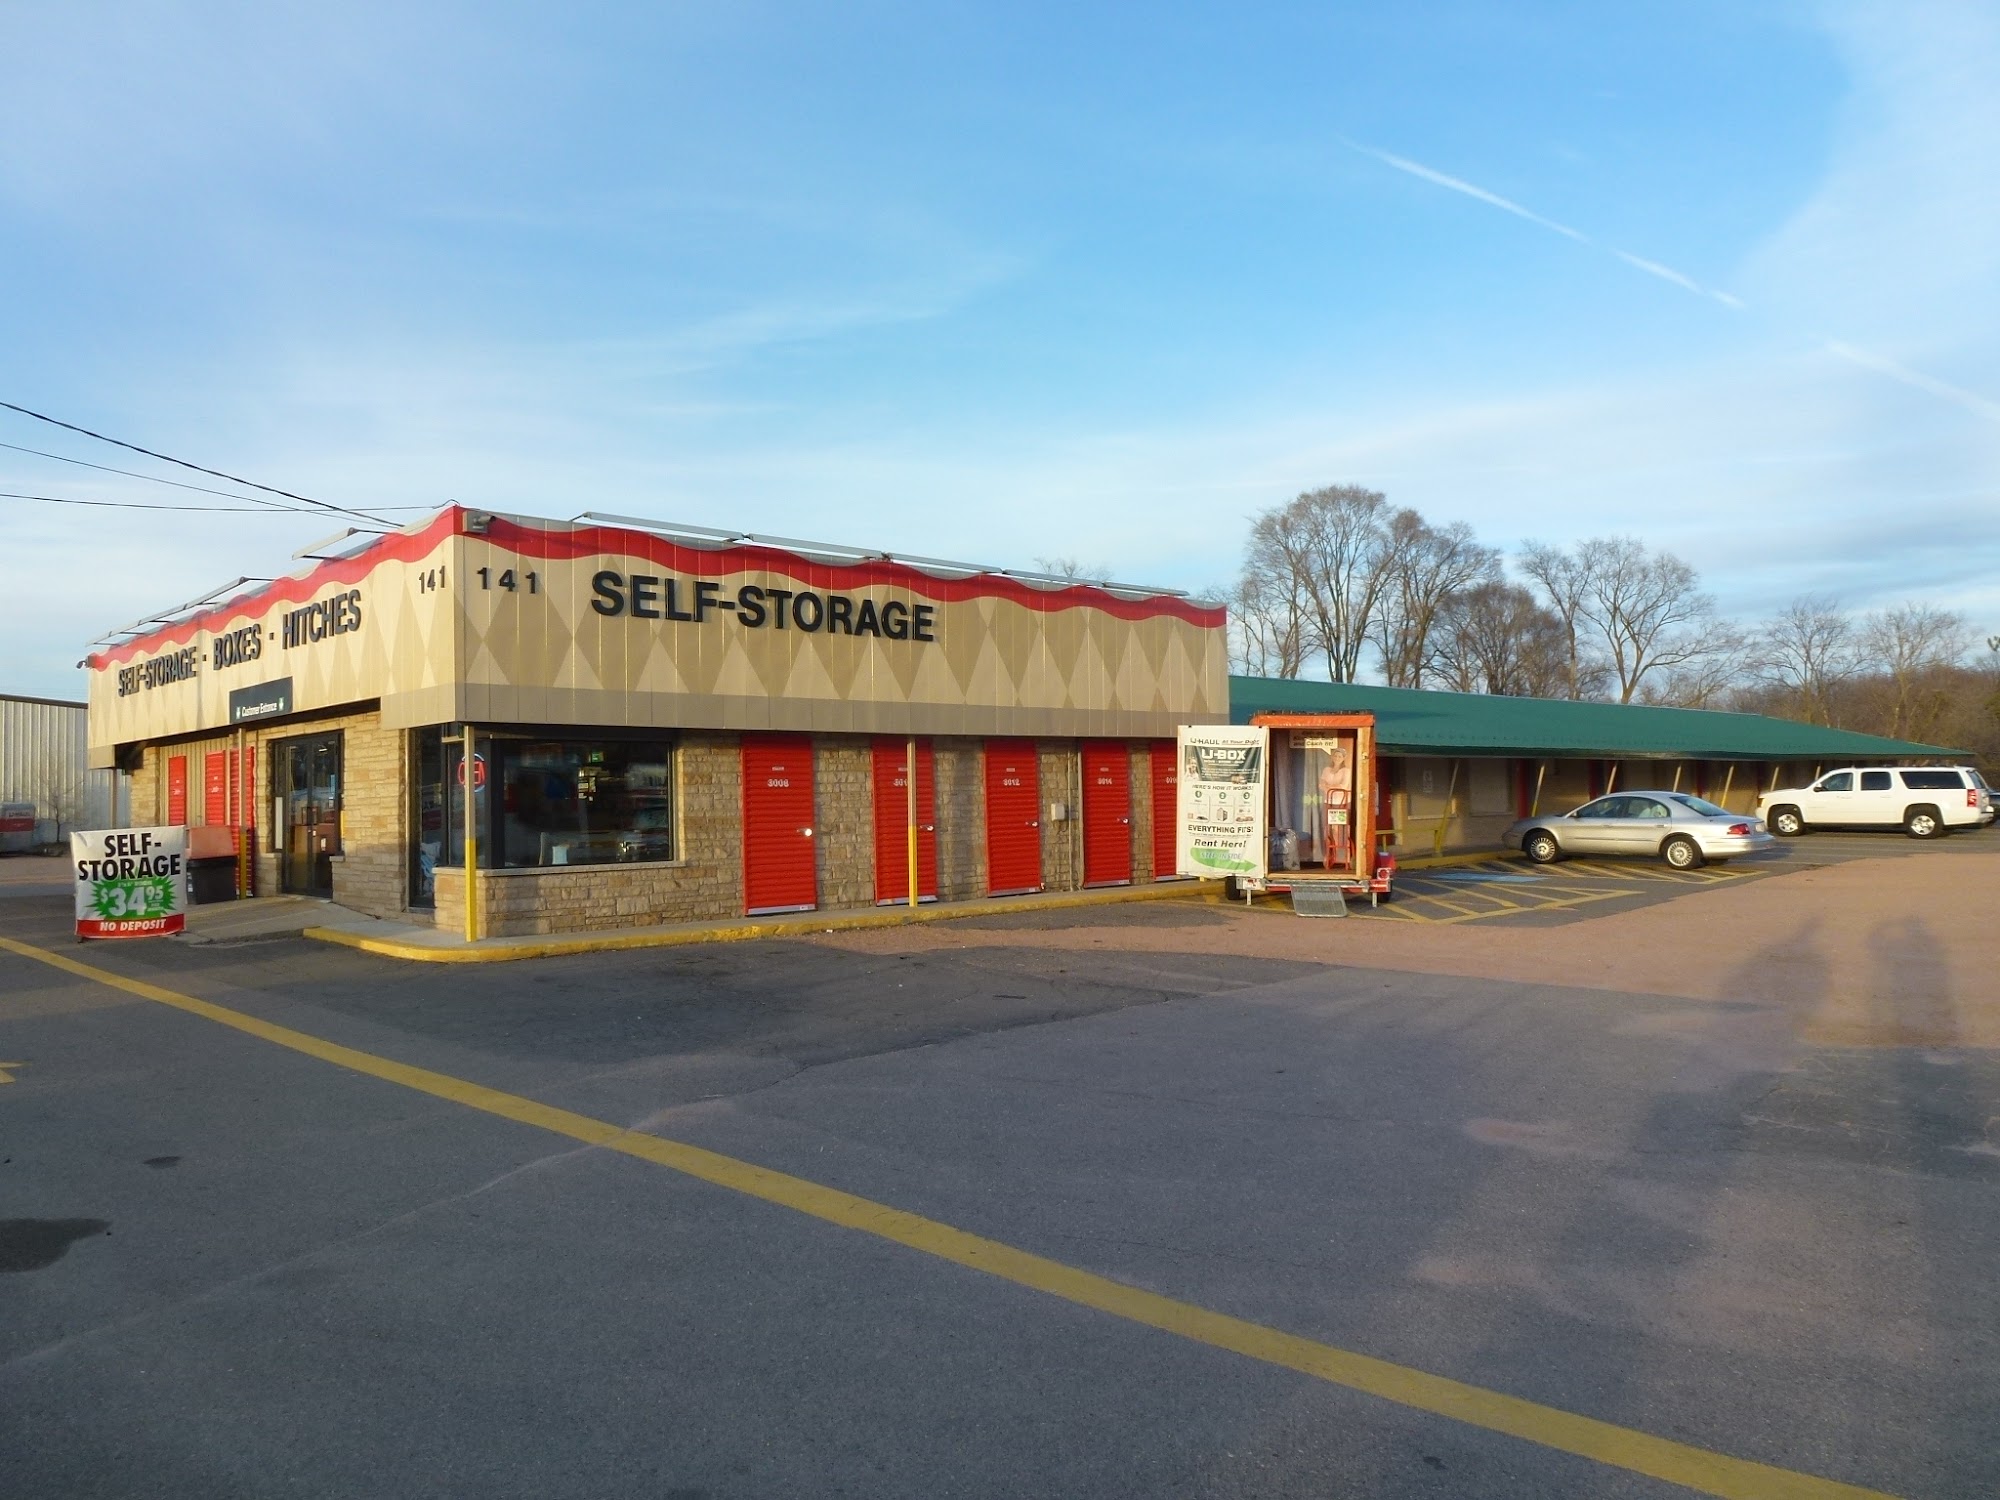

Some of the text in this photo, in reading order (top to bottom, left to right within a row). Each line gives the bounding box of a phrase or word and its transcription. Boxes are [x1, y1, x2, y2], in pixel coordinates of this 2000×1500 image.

[419, 566, 445, 594] 141
[476, 567, 536, 594] 141
[591, 571, 934, 641] SELF-STORAGE
[118, 589, 361, 697] SELF-STORAGE BOXES HITCHES
[1201, 749, 1246, 760] U-BOX
[1188, 825, 1235, 834] EVERYTHING
[104, 832, 161, 857] SELF-
[1194, 839, 1246, 848] Rent Here!
[78, 854, 181, 881] STORAGE
[100, 919, 166, 932] NO DEPOSIT
